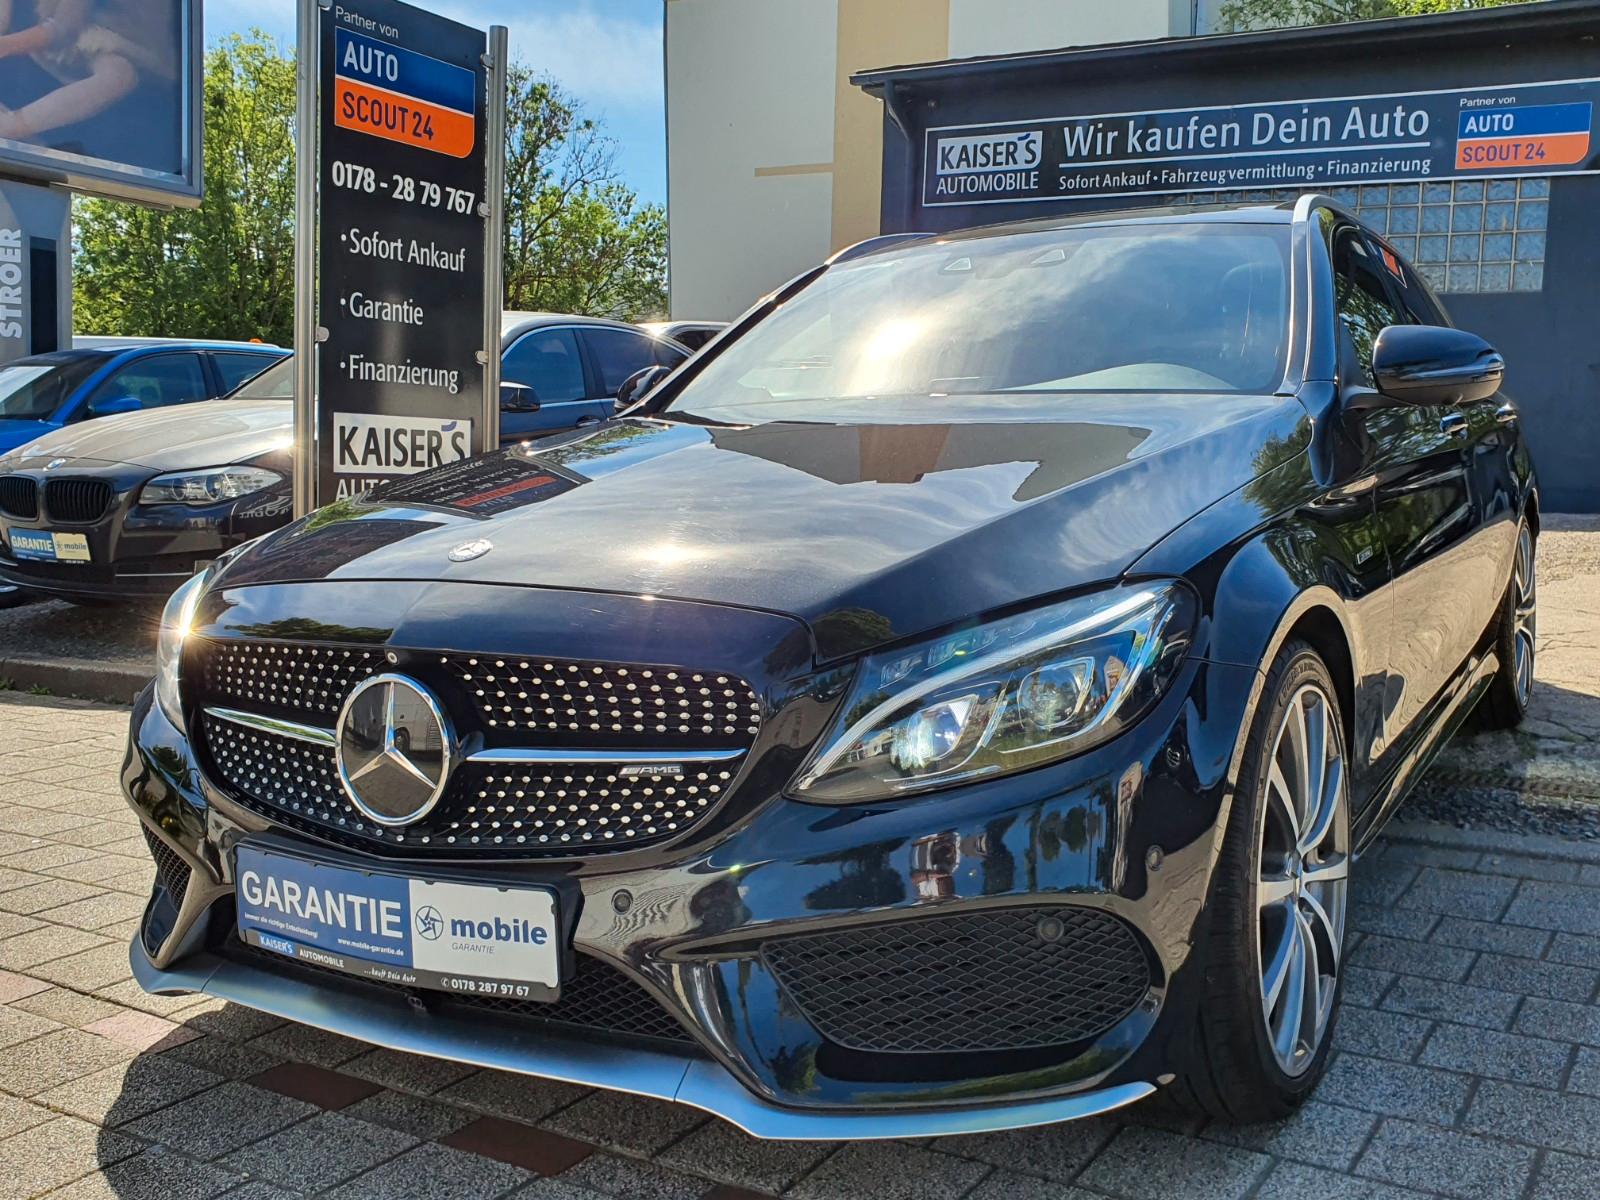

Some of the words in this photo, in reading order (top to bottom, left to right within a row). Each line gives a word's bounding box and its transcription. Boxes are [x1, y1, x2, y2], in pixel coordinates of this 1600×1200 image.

[336, 6, 376, 31] Partner
[379, 24, 399, 38] von
[343, 41, 399, 82] AUTO
[342, 91, 409, 133] SCOUT
[412, 111, 434, 141] 24
[1460, 97, 1496, 107] Partner
[1498, 96, 1516, 105] von
[1063, 122, 1118, 157] Wir
[1127, 116, 1240, 153] kaufen
[1252, 107, 1331, 146] Dein
[1341, 105, 1430, 141] Auto
[1465, 113, 1515, 134] AUTO
[1462, 143, 1522, 163] SCOUT
[1524, 142, 1546, 160] 24
[332, 160, 376, 193] 0178
[392, 174, 415, 202] 28
[419, 180, 441, 207] 79
[445, 186, 475, 215] 767
[936, 171, 1039, 195] AUTOMOBILE
[1059, 174, 1100, 190] Sofort
[1102, 170, 1151, 188] Ankauf
[1161, 161, 1316, 184] Fahrzeugvermittlung
[1327, 157, 1431, 175] Finanzierung
[350, 228, 403, 261] Sofort
[407, 240, 465, 272] Ankauf
[350, 291, 424, 325] Garantie
[349, 354, 459, 394] Finanzierung
[11, 535, 54, 552] GARANTIE
[241, 870, 403, 939] GARANTIE
[451, 916, 548, 946] mobile
[299, 948, 345, 969] AUTOMOBILE
[452, 942, 495, 954] GARANTIE
[451, 978, 476, 991] 0178
[478, 982, 498, 993] 287
[500, 984, 514, 995] 97
[516, 986, 529, 997] 67
